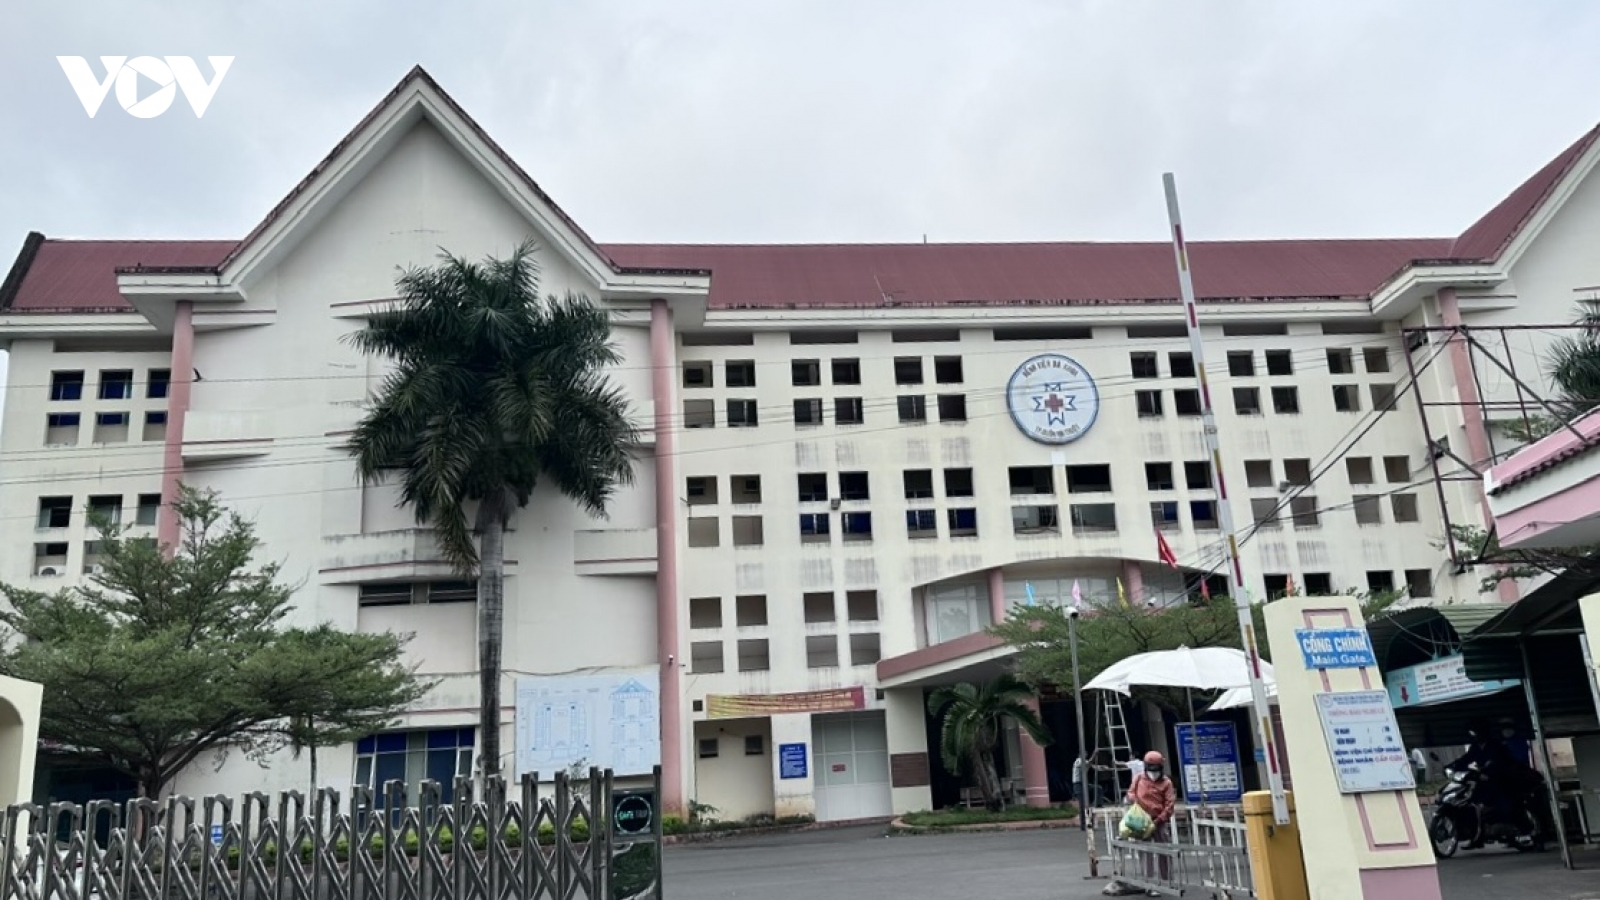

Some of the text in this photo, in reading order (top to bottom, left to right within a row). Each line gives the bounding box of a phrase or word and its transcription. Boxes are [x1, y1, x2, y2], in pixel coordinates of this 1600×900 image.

[1334, 633, 1368, 652] CHÍNH
[1312, 654, 1366, 664] Main Gate
